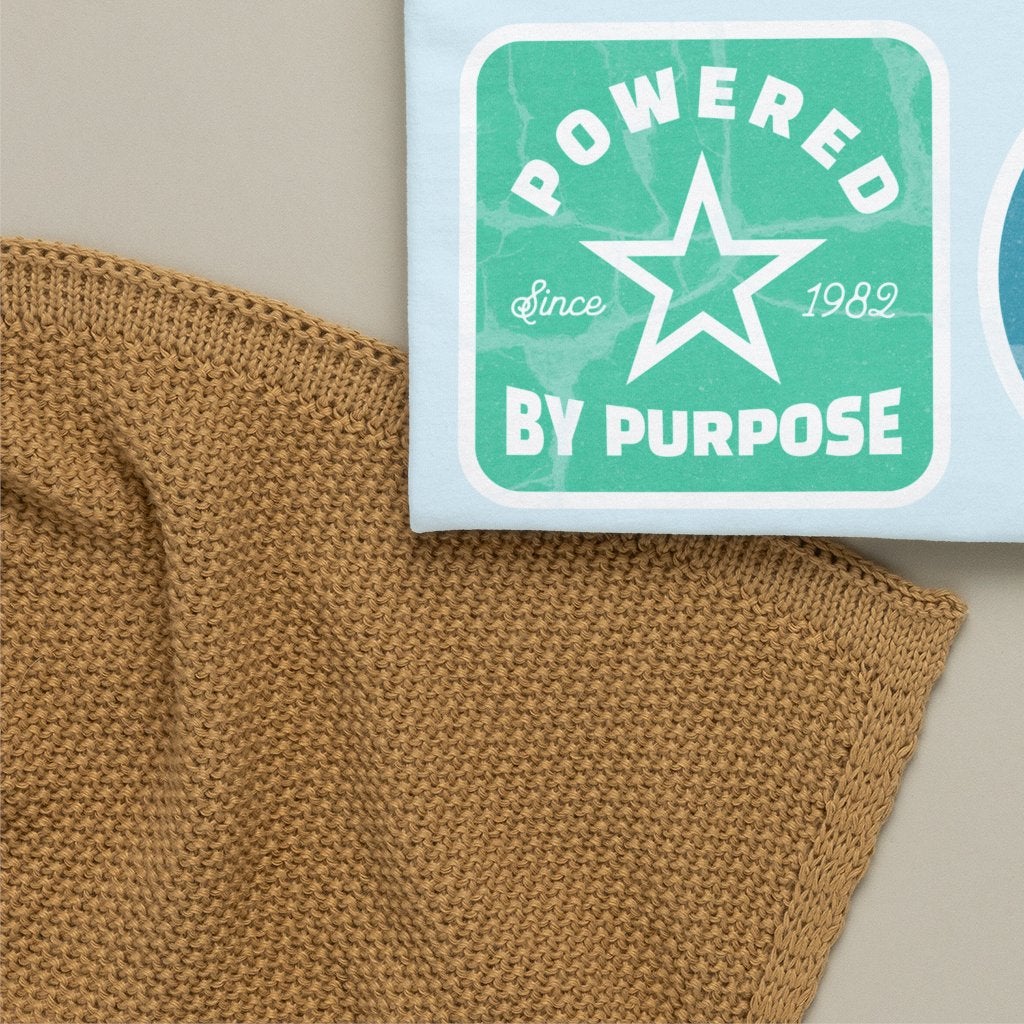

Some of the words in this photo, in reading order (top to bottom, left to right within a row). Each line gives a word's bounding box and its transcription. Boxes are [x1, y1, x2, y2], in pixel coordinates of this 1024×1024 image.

[510, 66, 900, 216] POWERED
[510, 279, 607, 325] Since
[801, 281, 899, 319] 1982
[505, 385, 585, 457] BY
[605, 387, 903, 457] PURPOSE
